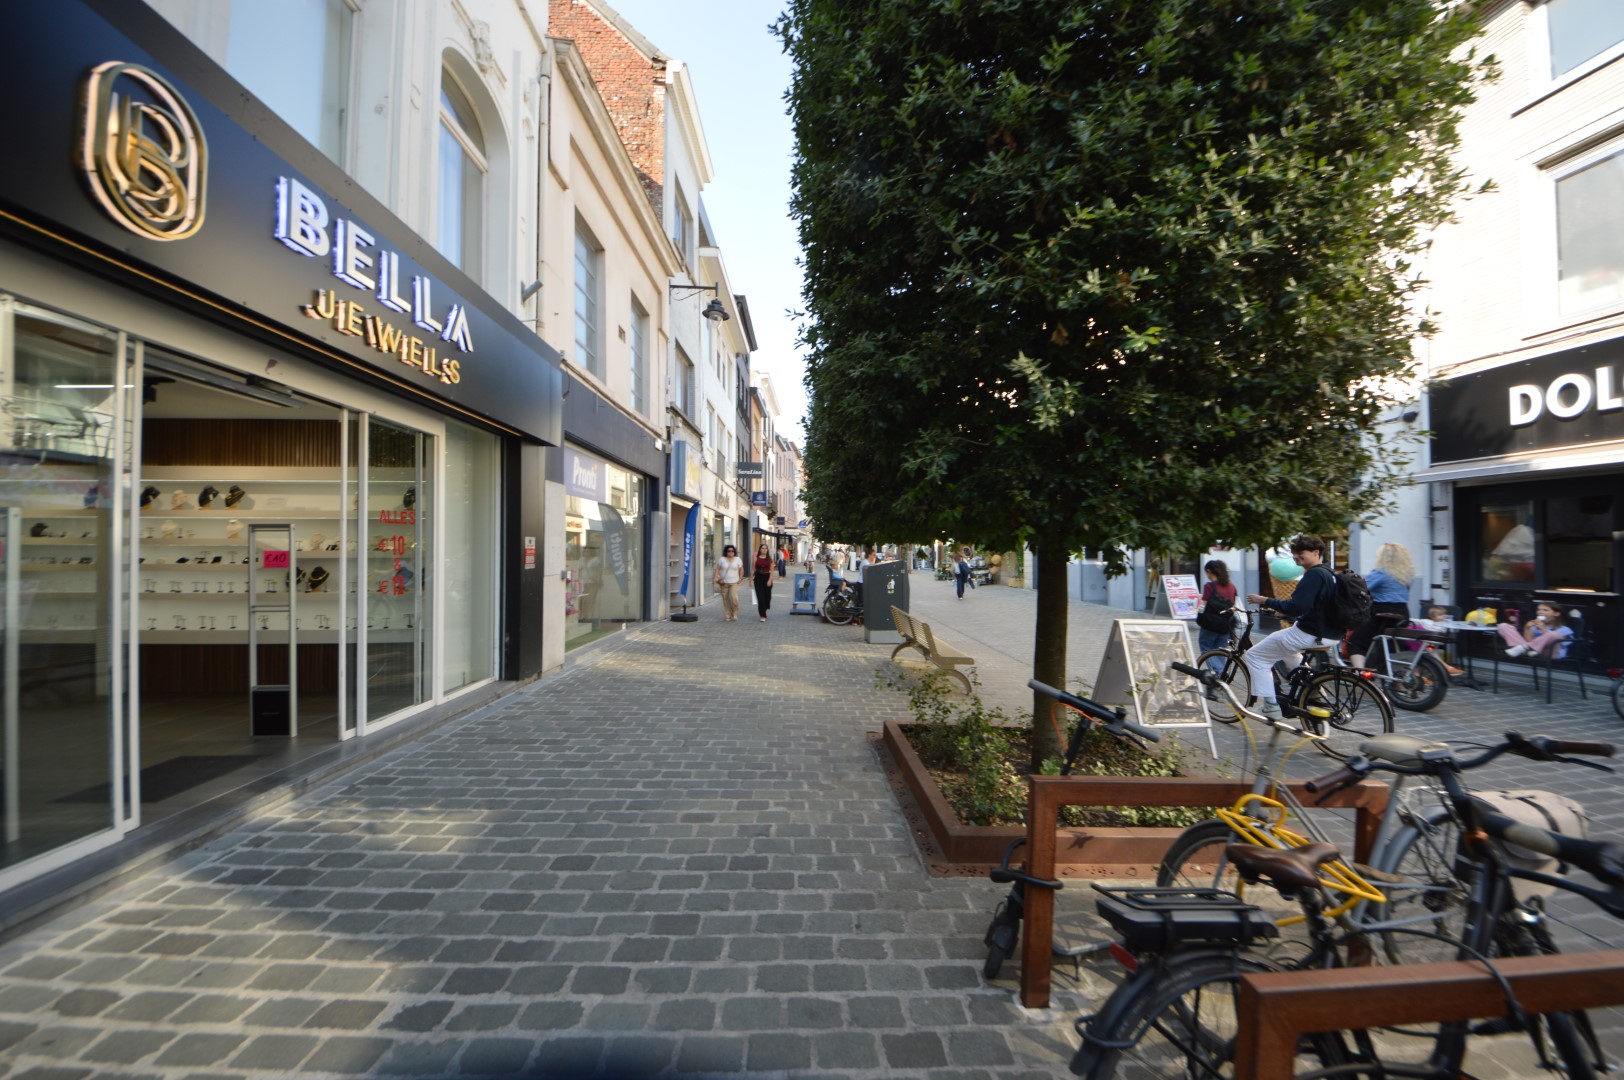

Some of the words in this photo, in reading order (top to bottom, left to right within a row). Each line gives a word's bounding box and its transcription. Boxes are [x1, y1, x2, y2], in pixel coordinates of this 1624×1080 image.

[275, 176, 474, 352] BELLA
[300, 288, 461, 384] JEWELS
[1509, 365, 1624, 426] DOL
[572, 455, 598, 490] Pronti
[378, 510, 416, 525] ALLES
